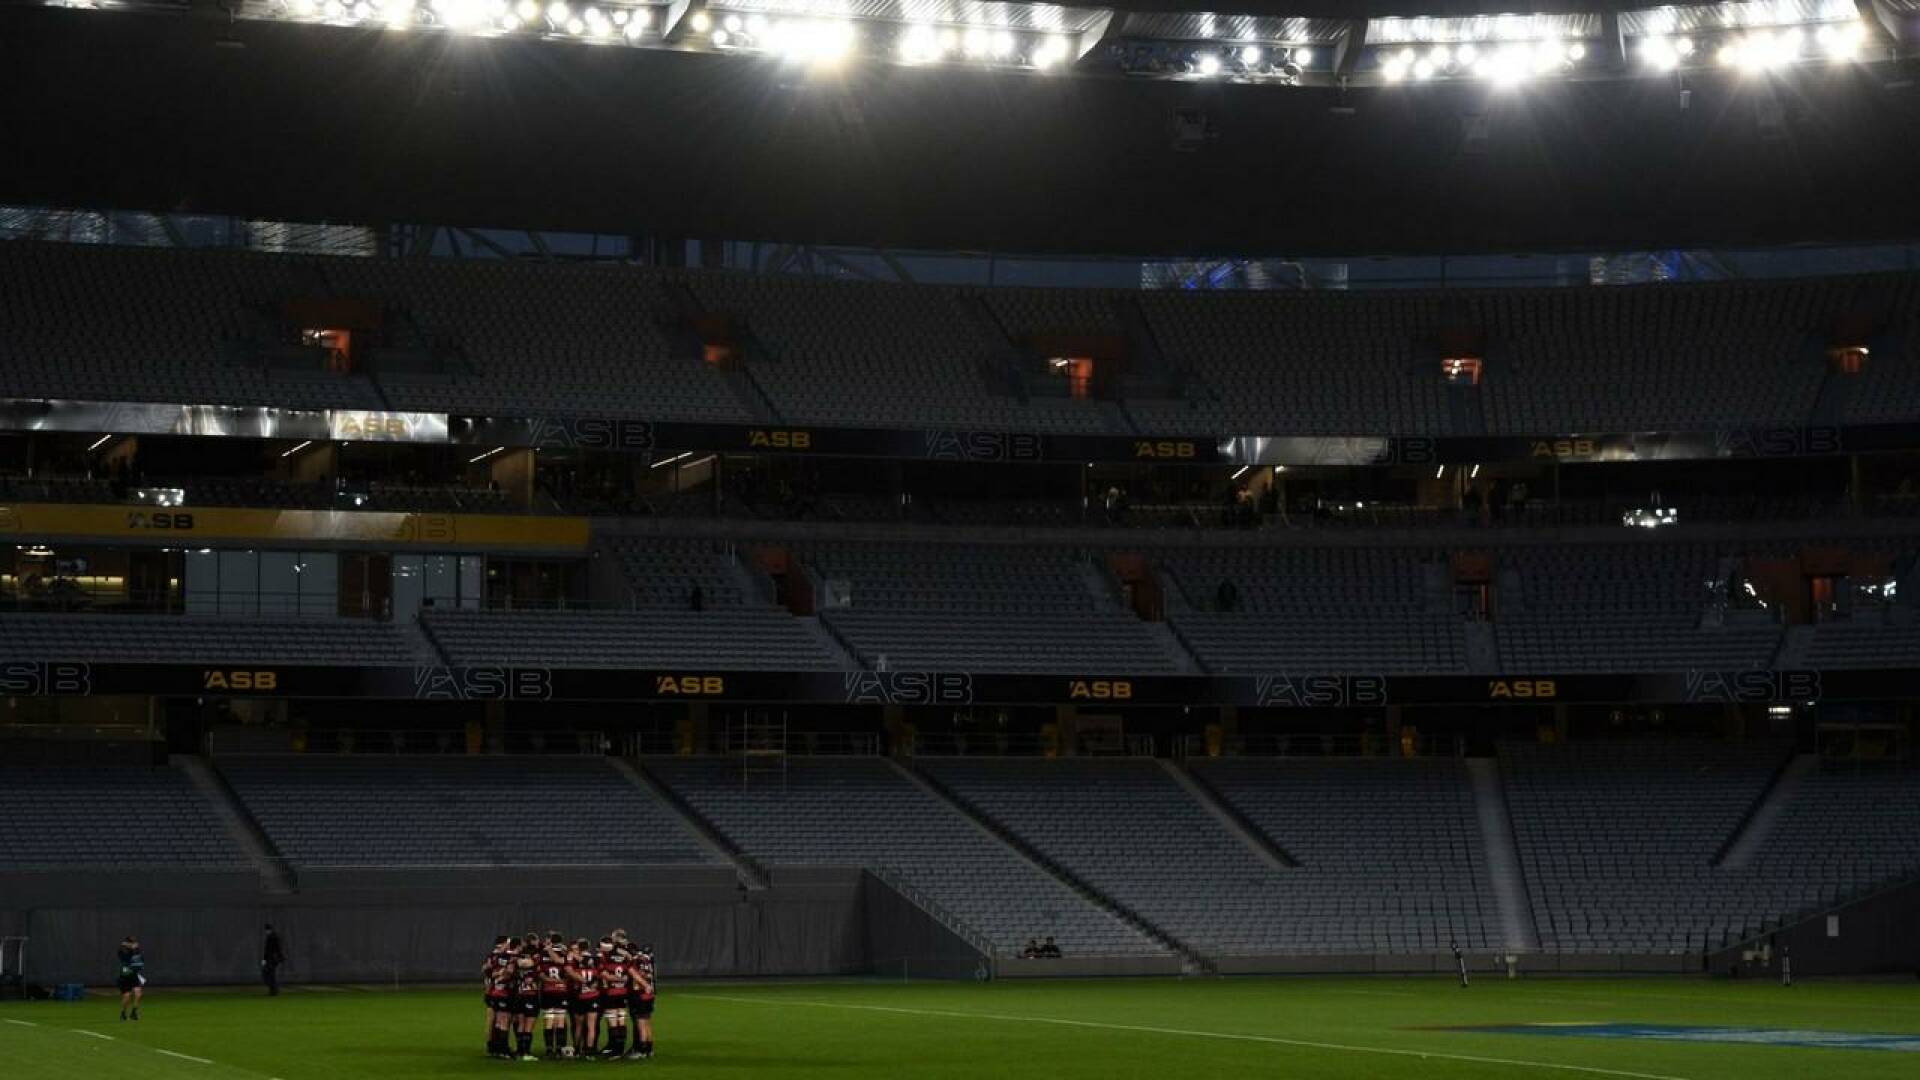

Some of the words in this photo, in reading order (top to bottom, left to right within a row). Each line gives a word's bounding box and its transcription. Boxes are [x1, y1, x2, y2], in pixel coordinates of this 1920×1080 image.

[340, 415, 405, 434] ASB
[528, 420, 655, 450] ASB
[747, 431, 811, 448] ASB
[1720, 428, 1844, 455] ASB
[926, 430, 1044, 462] ASB
[1133, 441, 1195, 458] ASB
[1532, 439, 1593, 457] ASB
[204, 671, 276, 689] ASB
[415, 665, 552, 700] ASB
[655, 675, 724, 694] ASB
[842, 671, 973, 704] ASB
[1070, 680, 1131, 699] ASB
[1255, 672, 1387, 707] ASB
[1488, 679, 1555, 698] ASB
[1685, 669, 1823, 702] ASB
